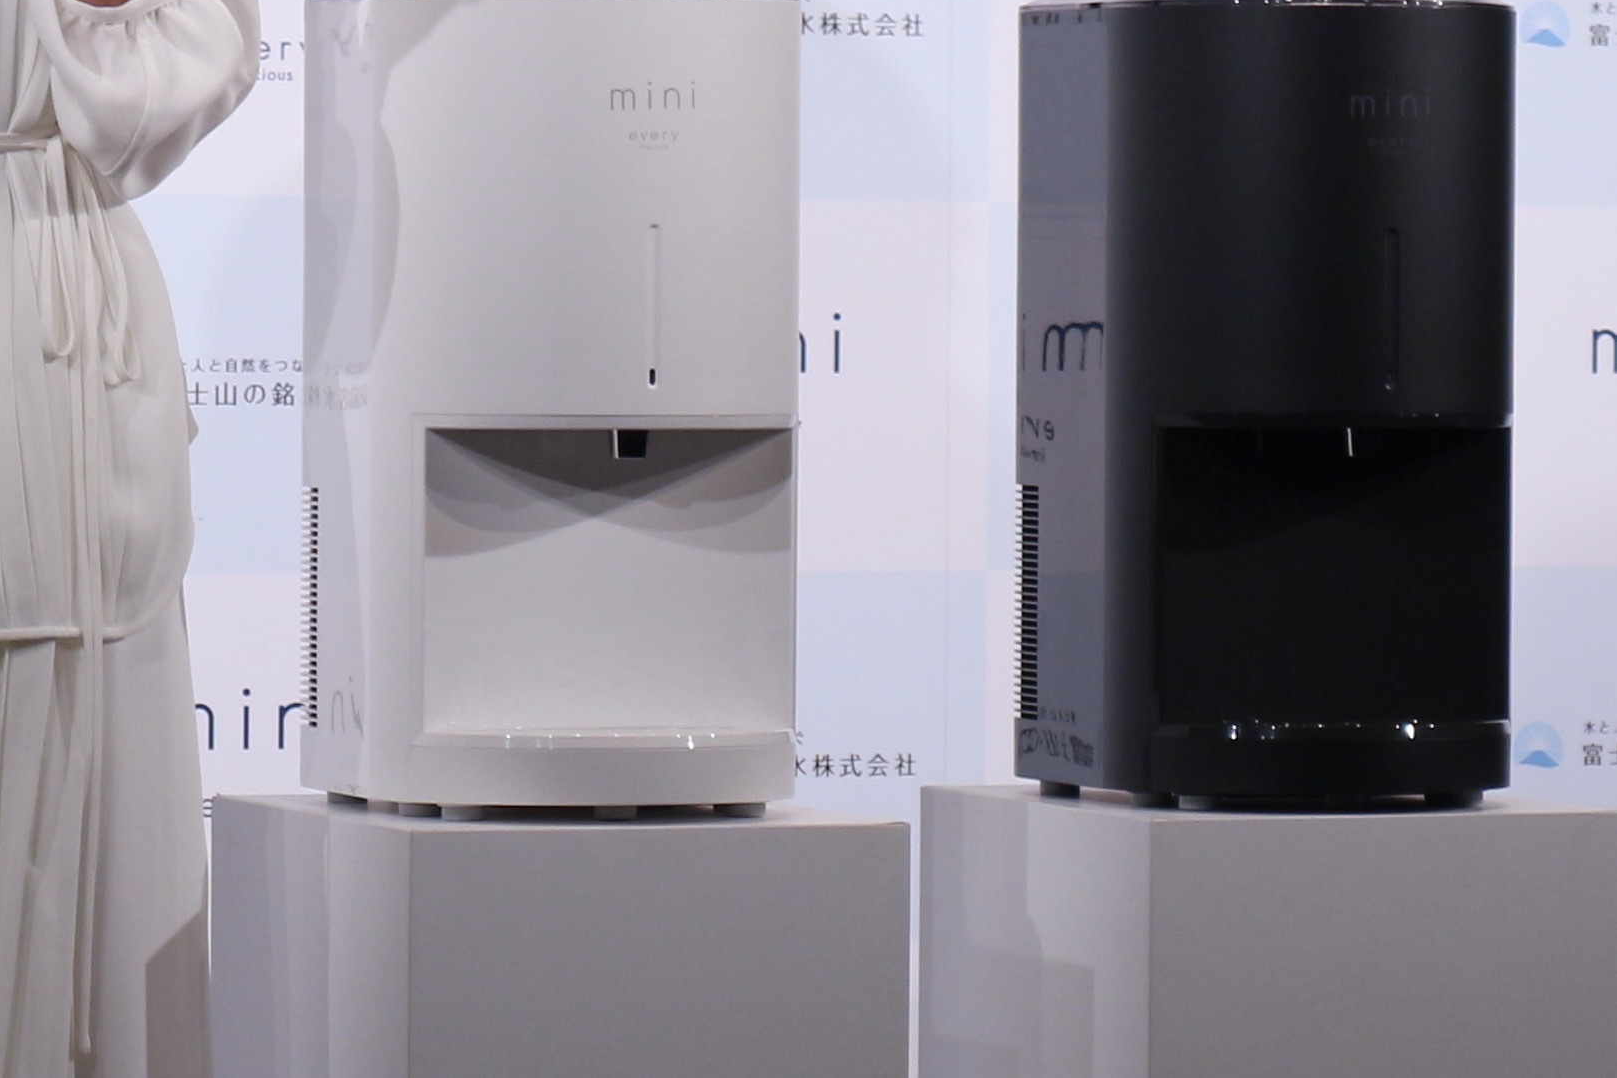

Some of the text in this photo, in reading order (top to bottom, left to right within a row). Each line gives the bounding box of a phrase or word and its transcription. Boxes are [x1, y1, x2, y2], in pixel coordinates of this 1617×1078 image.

[610, 81, 695, 111] mini
[1350, 88, 1431, 119] mini
[628, 131, 679, 141] every
